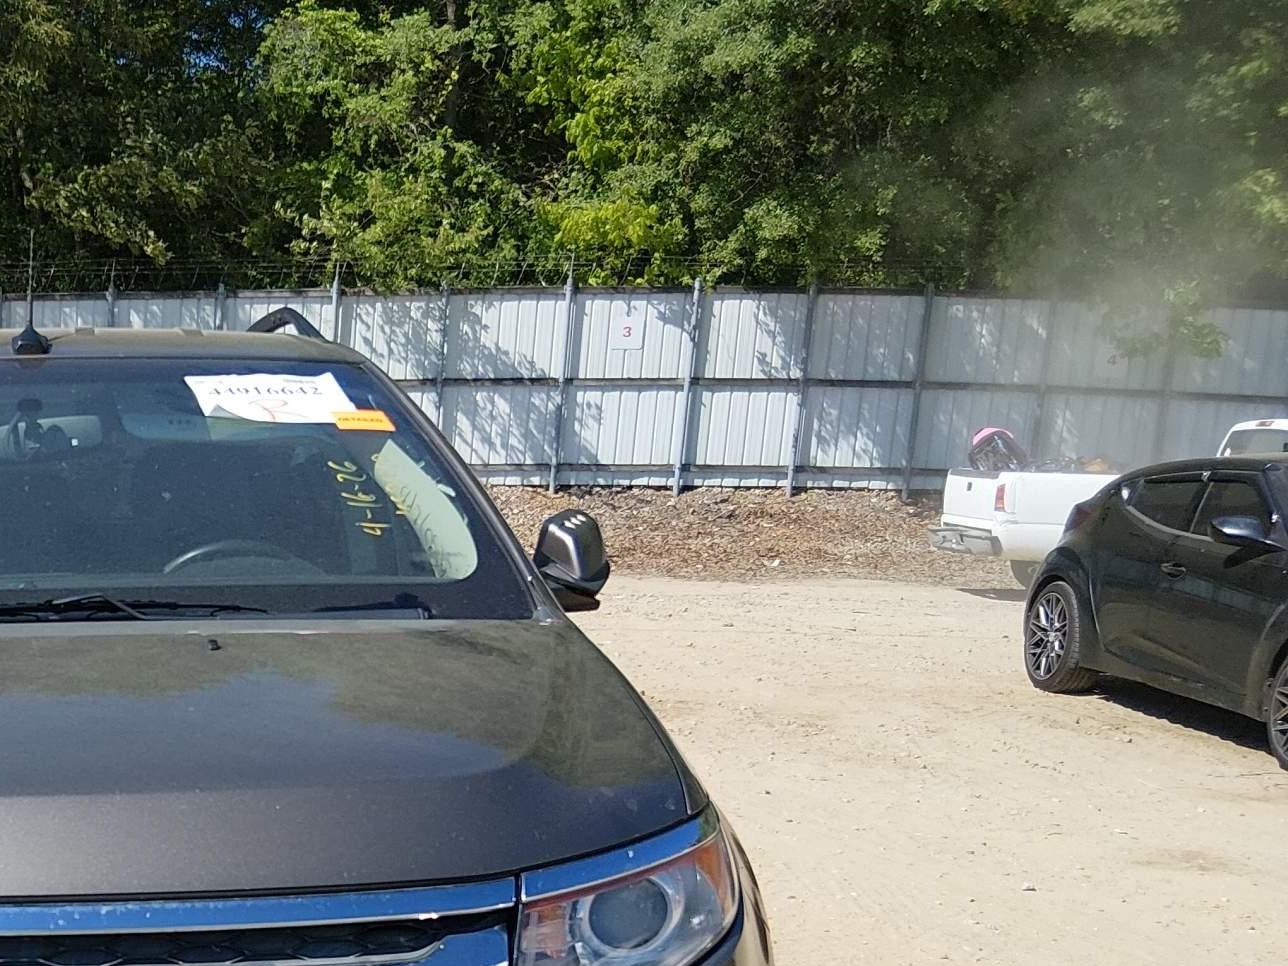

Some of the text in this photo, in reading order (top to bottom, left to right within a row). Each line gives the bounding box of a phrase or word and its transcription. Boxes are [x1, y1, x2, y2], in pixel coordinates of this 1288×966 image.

[623, 326, 632, 337] 3
[208, 386, 324, 397] 44916642
[326, 460, 393, 536] 4-16-26
